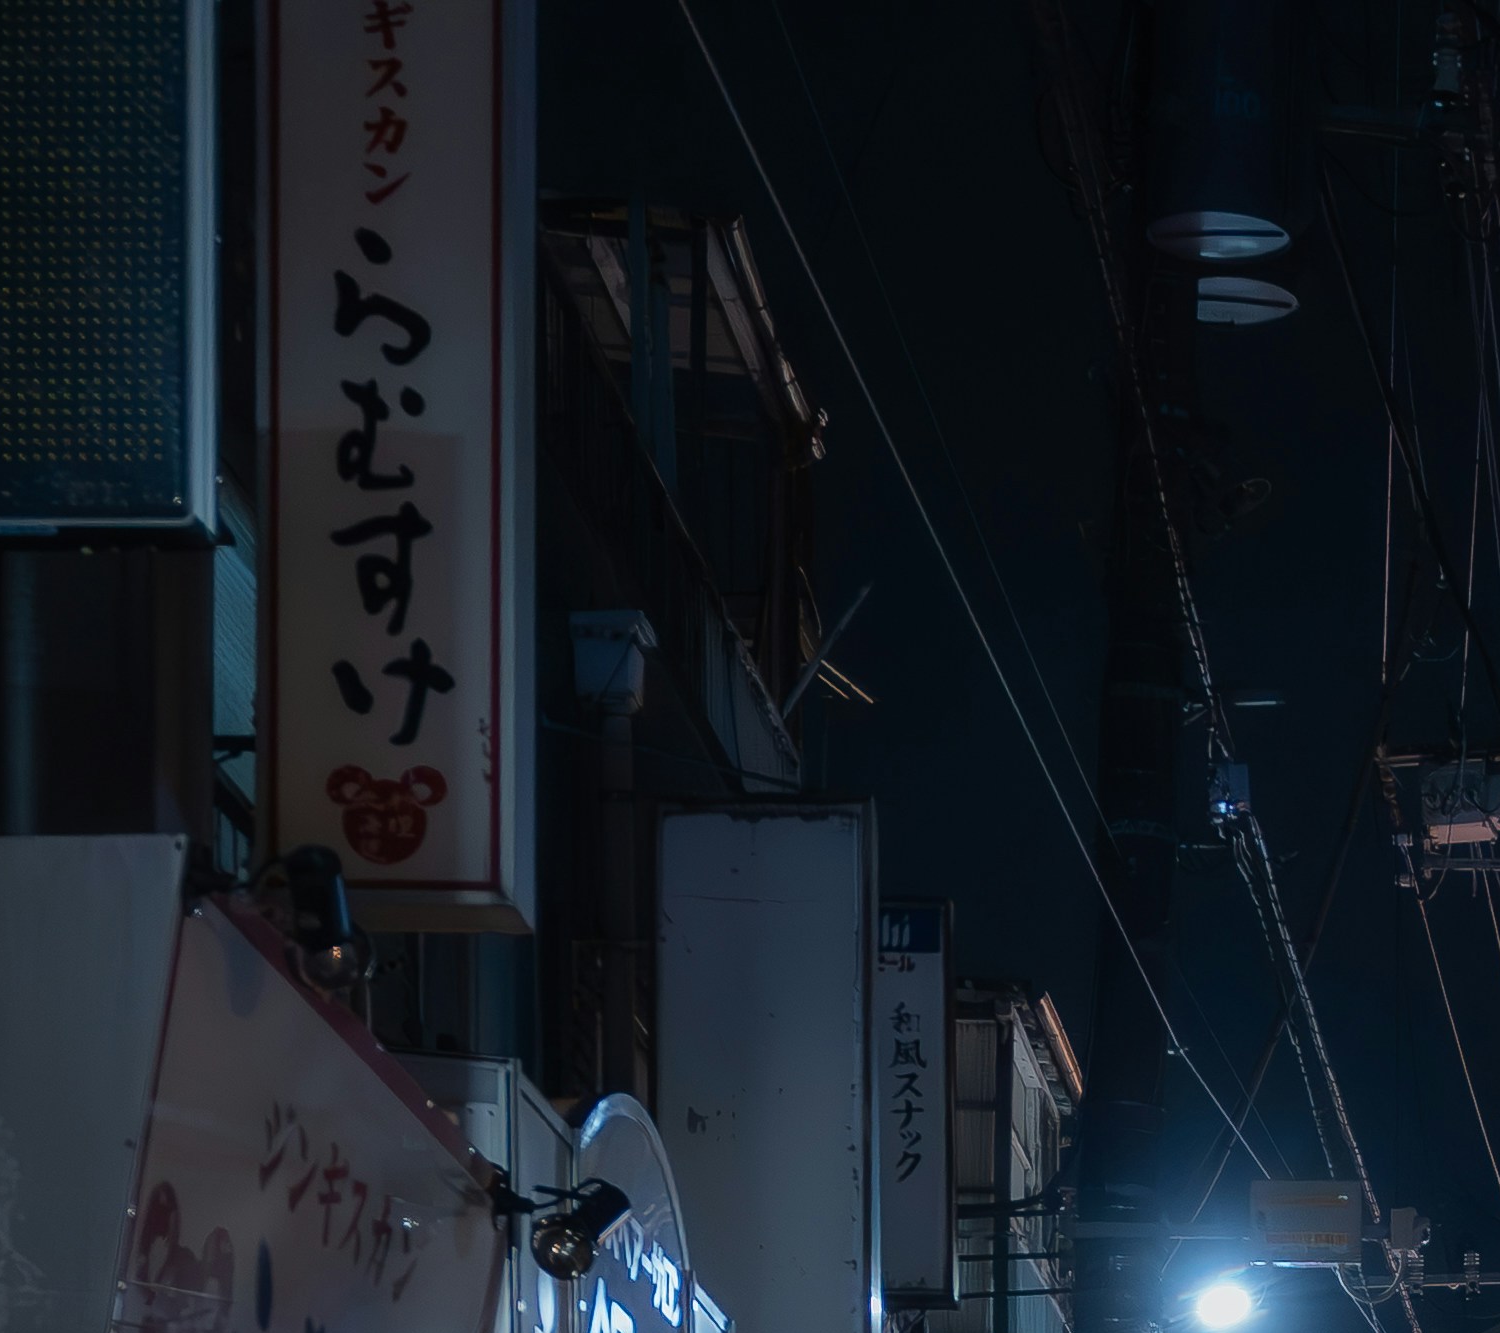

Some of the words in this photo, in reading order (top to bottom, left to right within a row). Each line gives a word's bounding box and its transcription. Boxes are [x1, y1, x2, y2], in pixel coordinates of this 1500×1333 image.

[331, 227, 455, 746] らむすけ
[888, 1001, 928, 1183] 和風スナック
